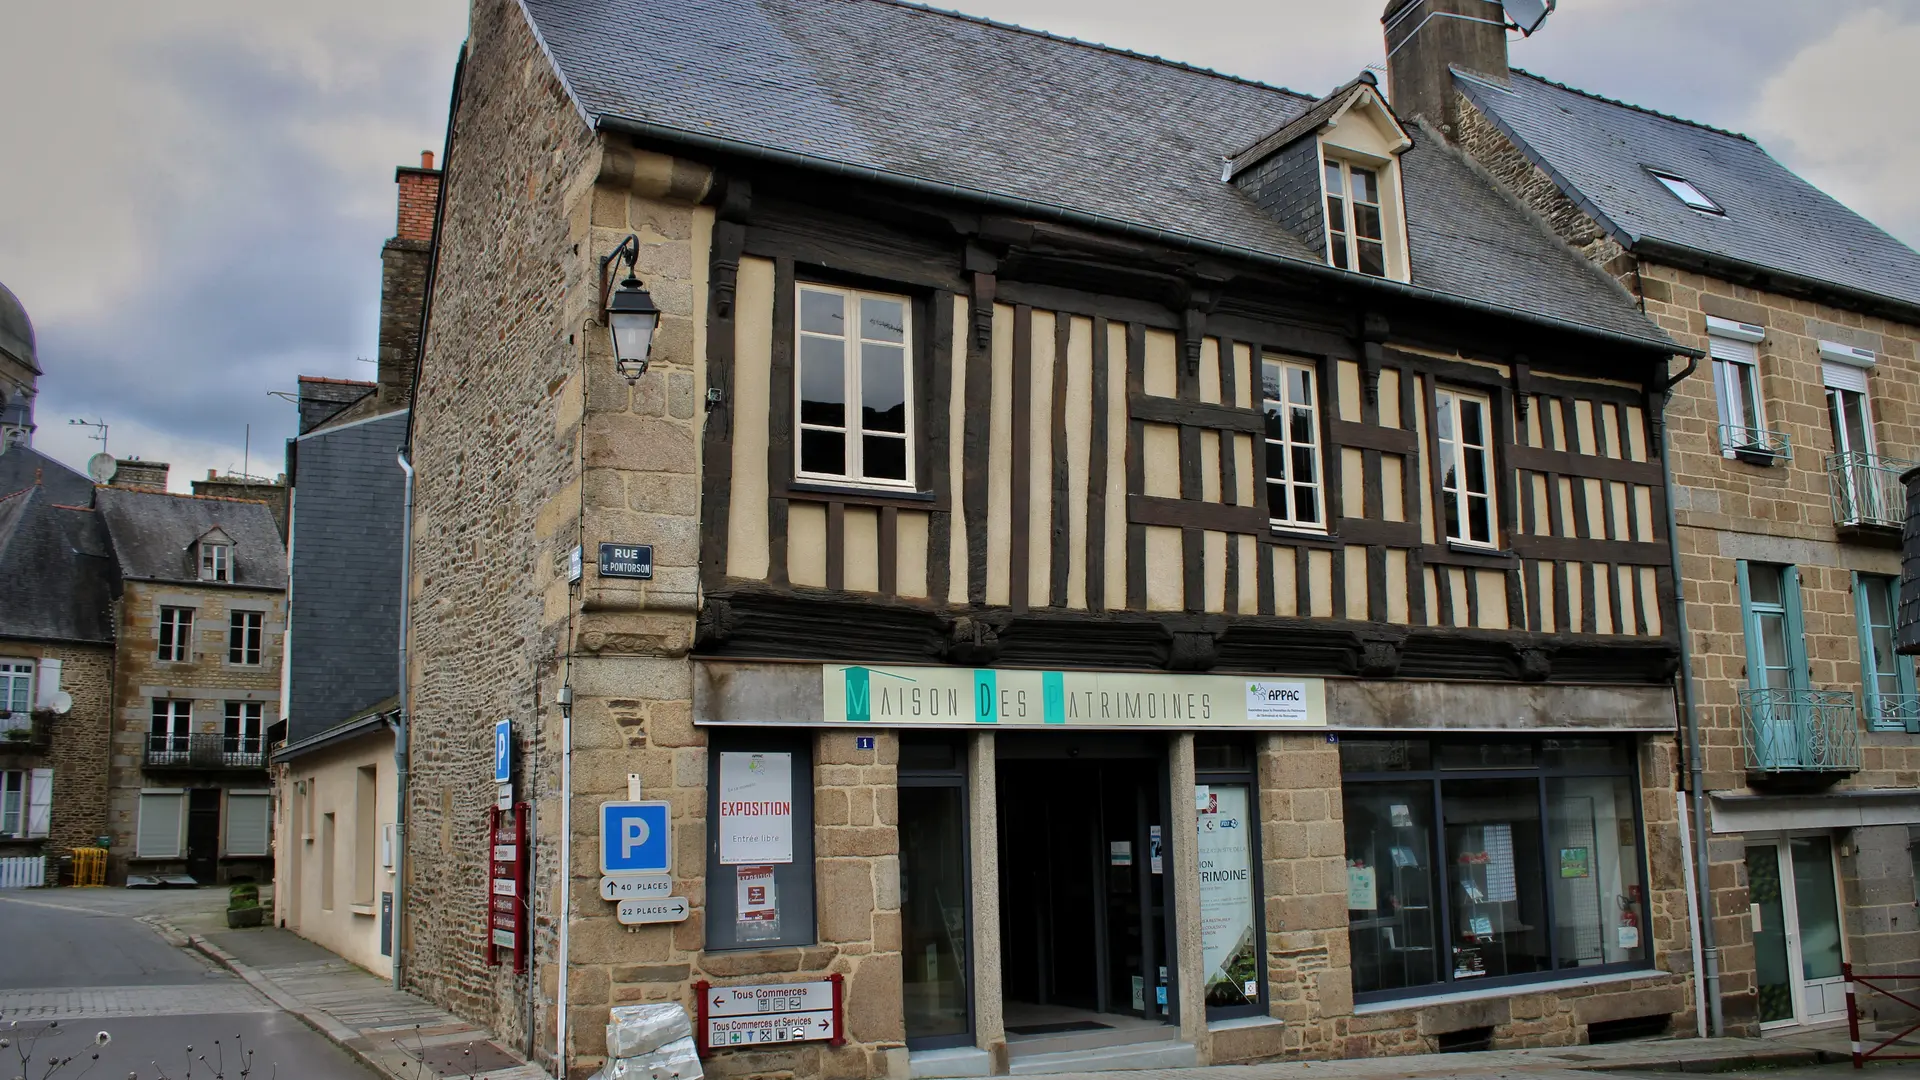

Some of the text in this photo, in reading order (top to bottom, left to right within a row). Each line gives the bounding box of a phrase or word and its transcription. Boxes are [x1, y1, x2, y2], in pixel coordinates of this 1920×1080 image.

[614, 548, 638, 559] RUE
[610, 562, 650, 574] PONTORSON
[846, 678, 1211, 720] MAISON DES PATRIMOINES
[1268, 690, 1300, 701] APPAC
[862, 738, 869, 747] 1
[498, 732, 506, 771] P
[721, 801, 791, 817] EXPOSITION
[621, 817, 650, 859] P
[732, 833, 780, 842] Entrée libre
[621, 881, 668, 891] 40 PLACES
[622, 906, 668, 916] 22 PLACES
[731, 987, 807, 999] Tous Commerces
[712, 1016, 812, 1031] Tous Commerces et Services
